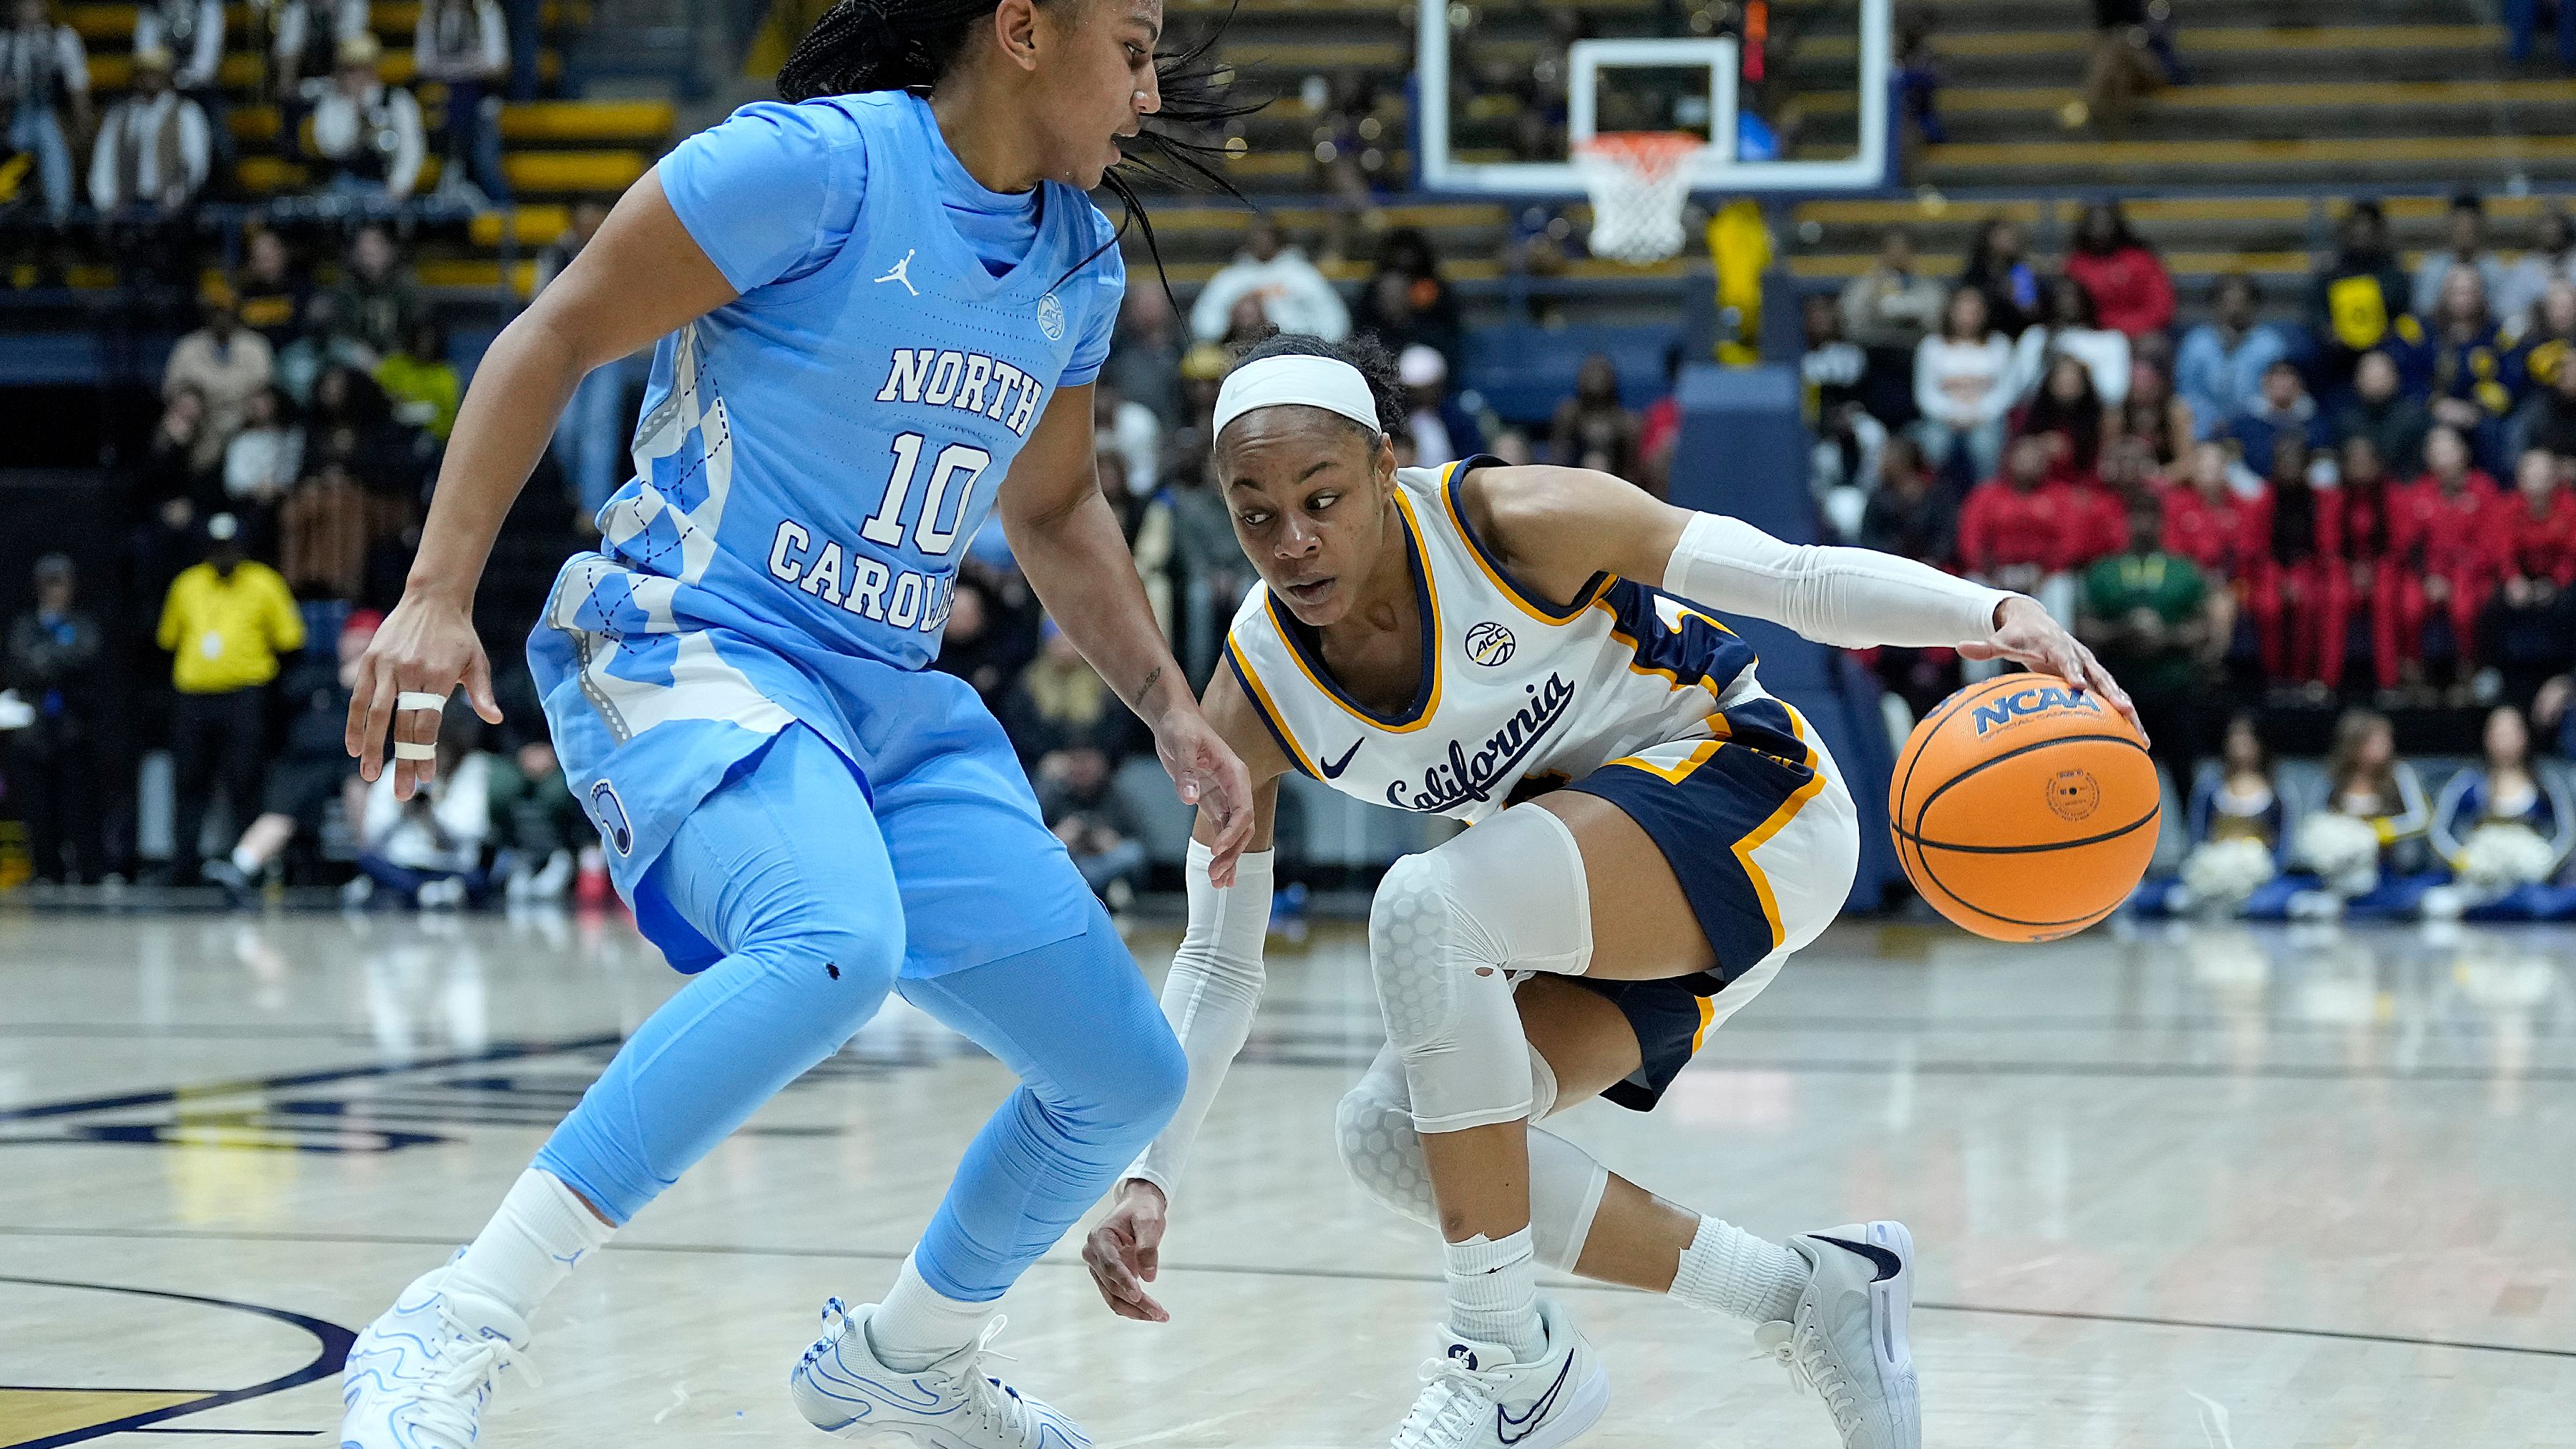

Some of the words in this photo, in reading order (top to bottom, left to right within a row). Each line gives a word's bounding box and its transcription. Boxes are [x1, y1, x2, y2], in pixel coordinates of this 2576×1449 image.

[1042, 308, 1062, 321] ACC
[876, 348, 1043, 437] NORTH
[861, 431, 992, 555] 10
[768, 519, 955, 633] CAROLI
[1475, 626, 1508, 658] ACC
[1386, 671, 1575, 813] California
[1971, 686, 2102, 738] NCAA
